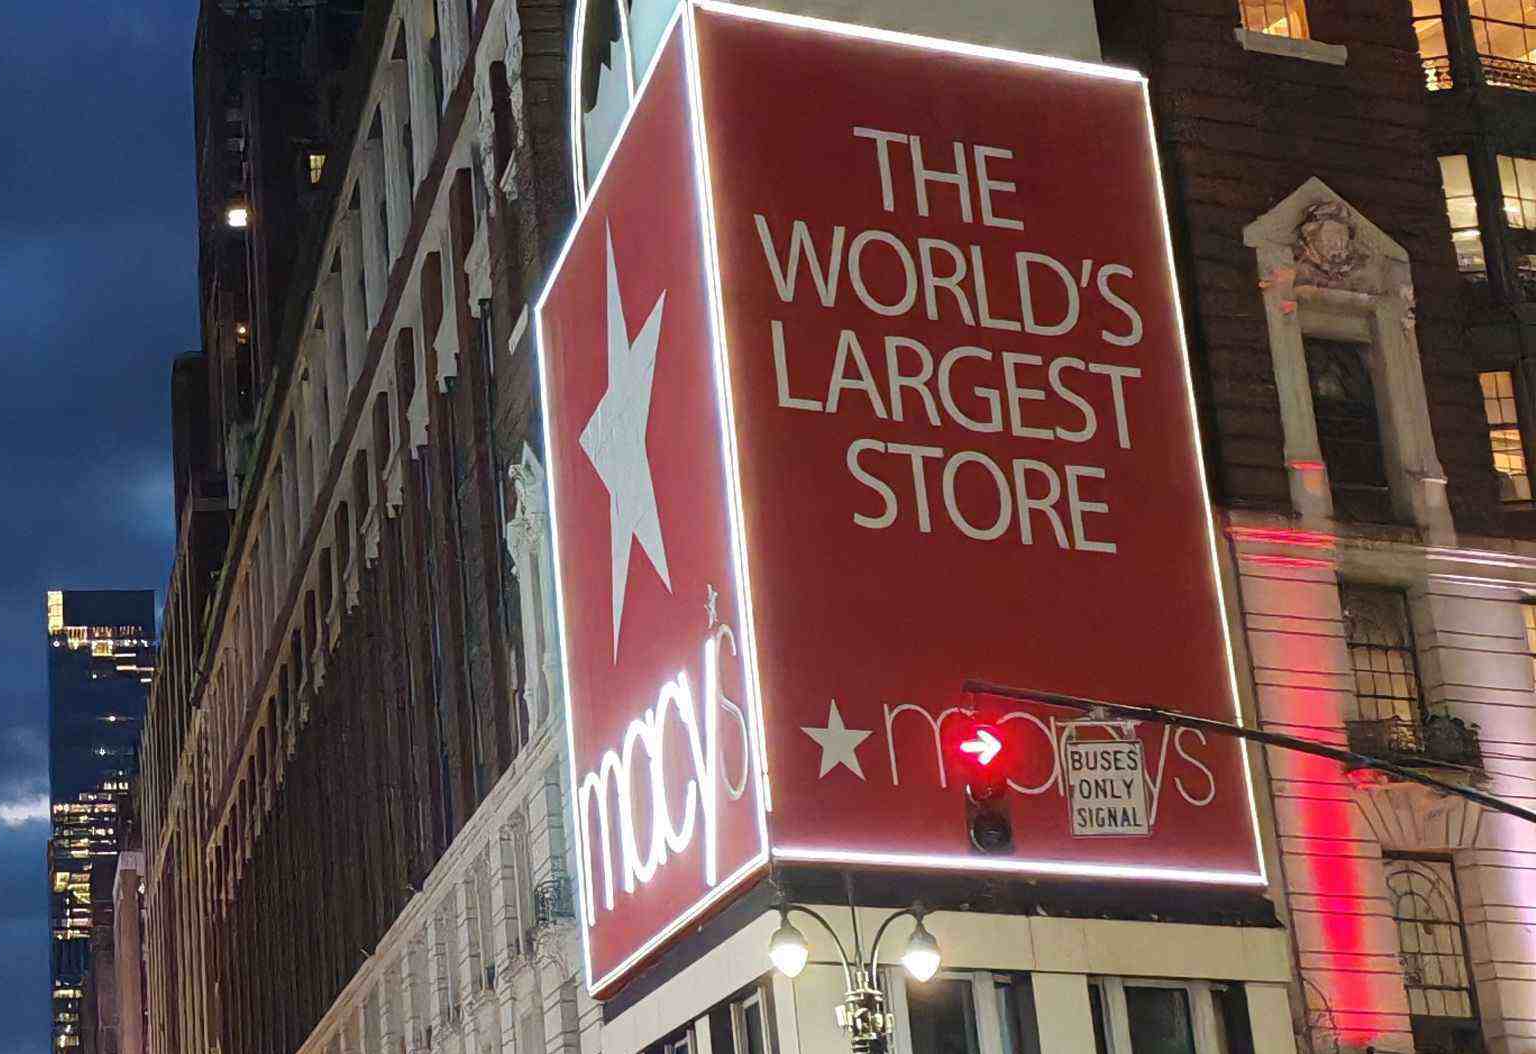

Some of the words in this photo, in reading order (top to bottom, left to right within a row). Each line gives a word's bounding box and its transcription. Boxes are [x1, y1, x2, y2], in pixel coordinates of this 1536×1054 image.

[852, 126, 1025, 231] THE
[753, 213, 1144, 348] WORLD'S
[770, 319, 1142, 449] LARGEST
[846, 438, 1118, 554] STORE
[1070, 750, 1139, 771] BUSES
[1079, 778, 1134, 799] ONLY
[1077, 806, 1143, 828] SIGNAL
